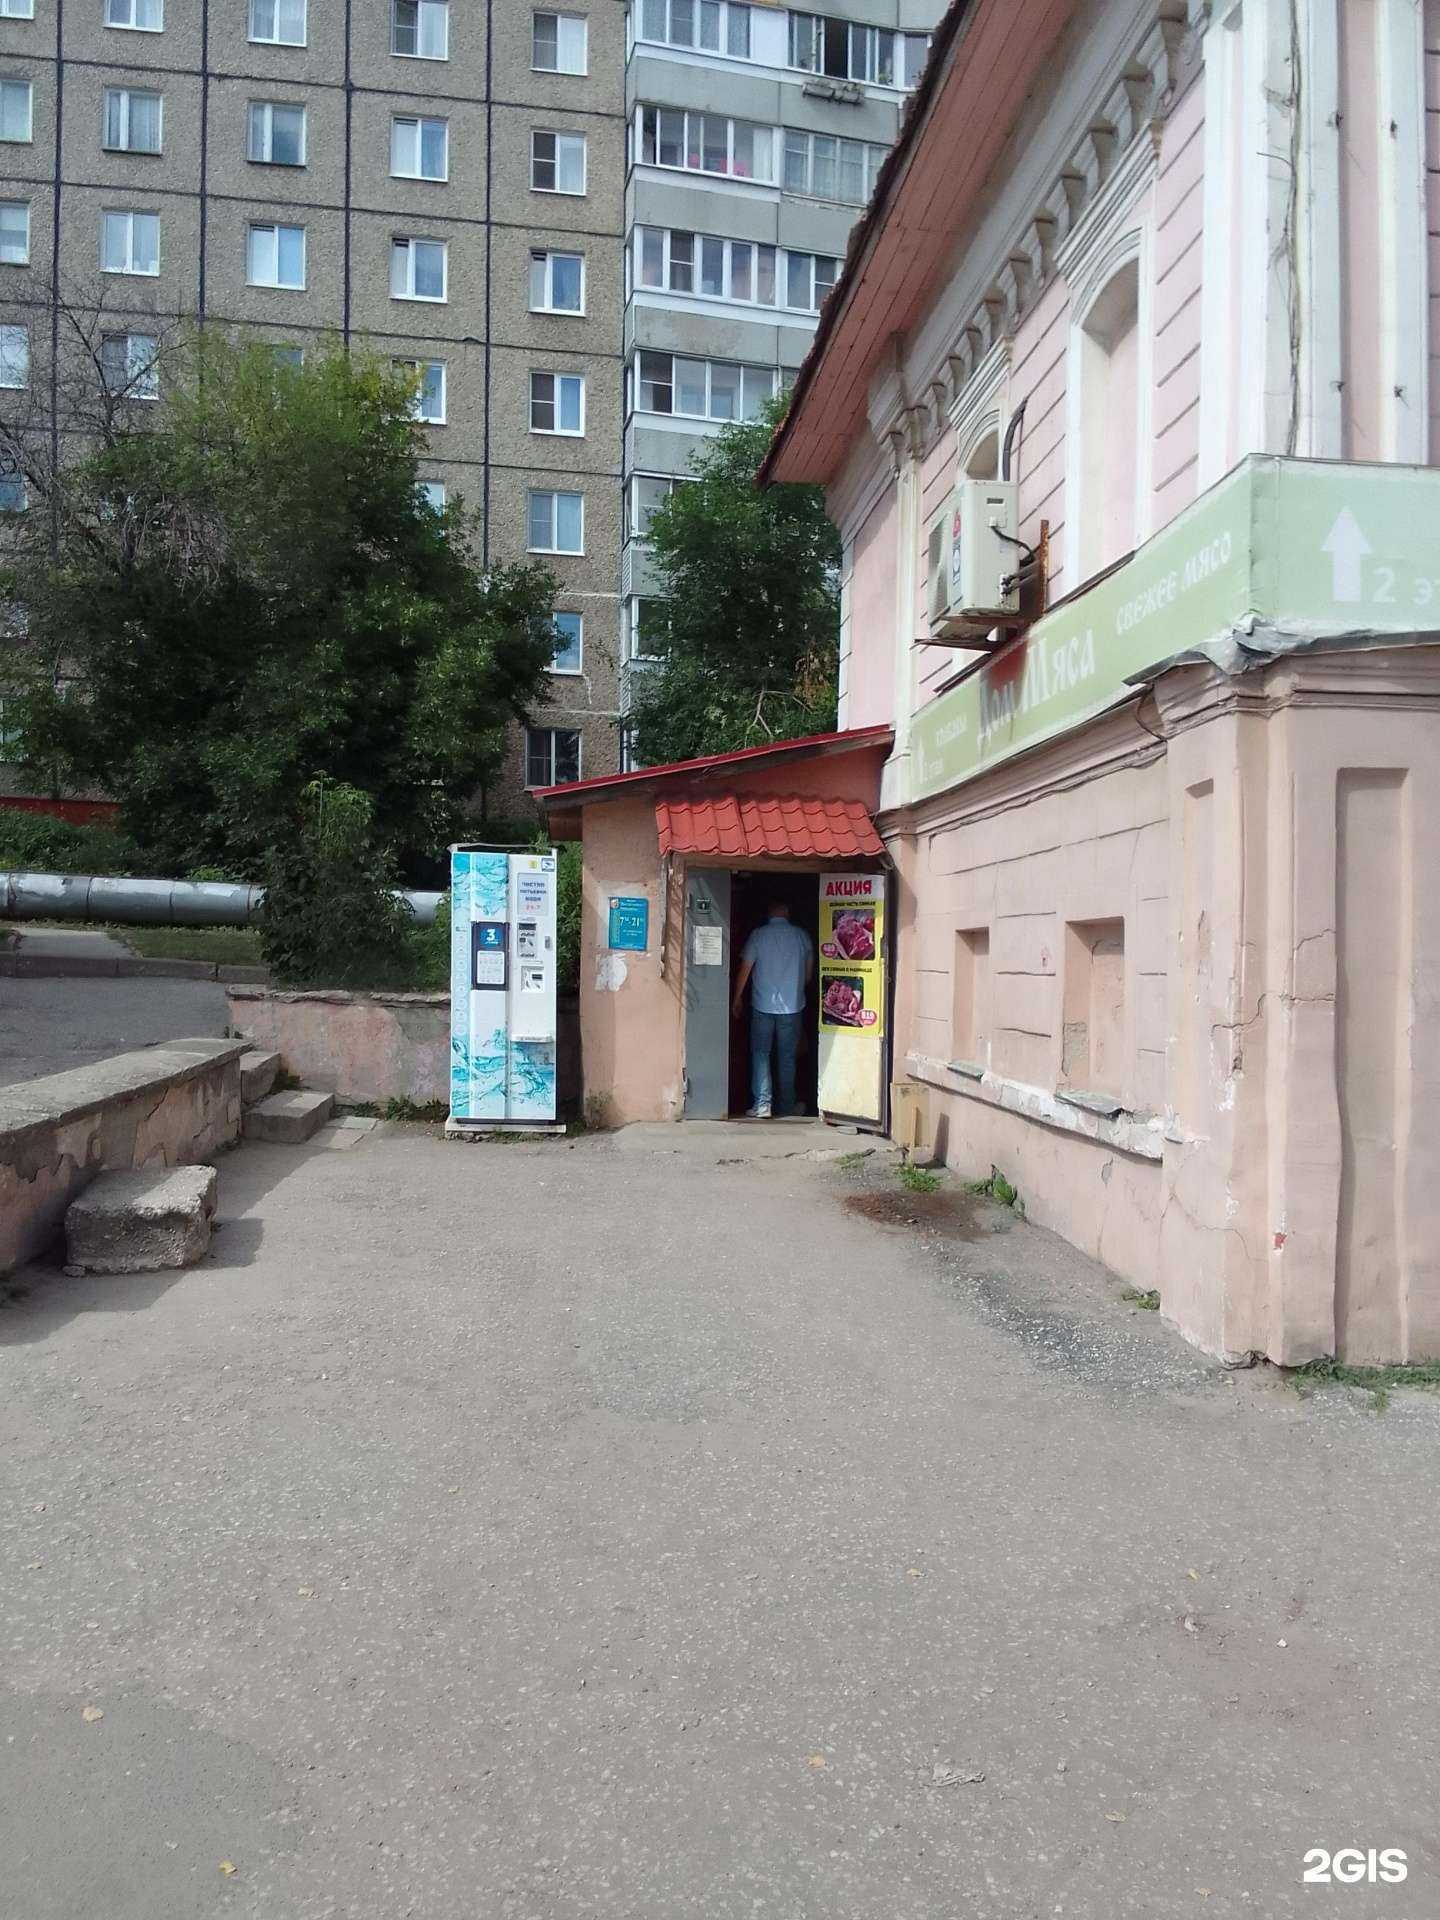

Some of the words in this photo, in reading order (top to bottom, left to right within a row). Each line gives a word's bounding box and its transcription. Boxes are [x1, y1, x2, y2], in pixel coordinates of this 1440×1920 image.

[1373, 567, 1396, 602] 2
[1413, 577, 1440, 604] э
[826, 880, 873, 897] АКЦИЯ
[486, 928, 496, 941] 3
